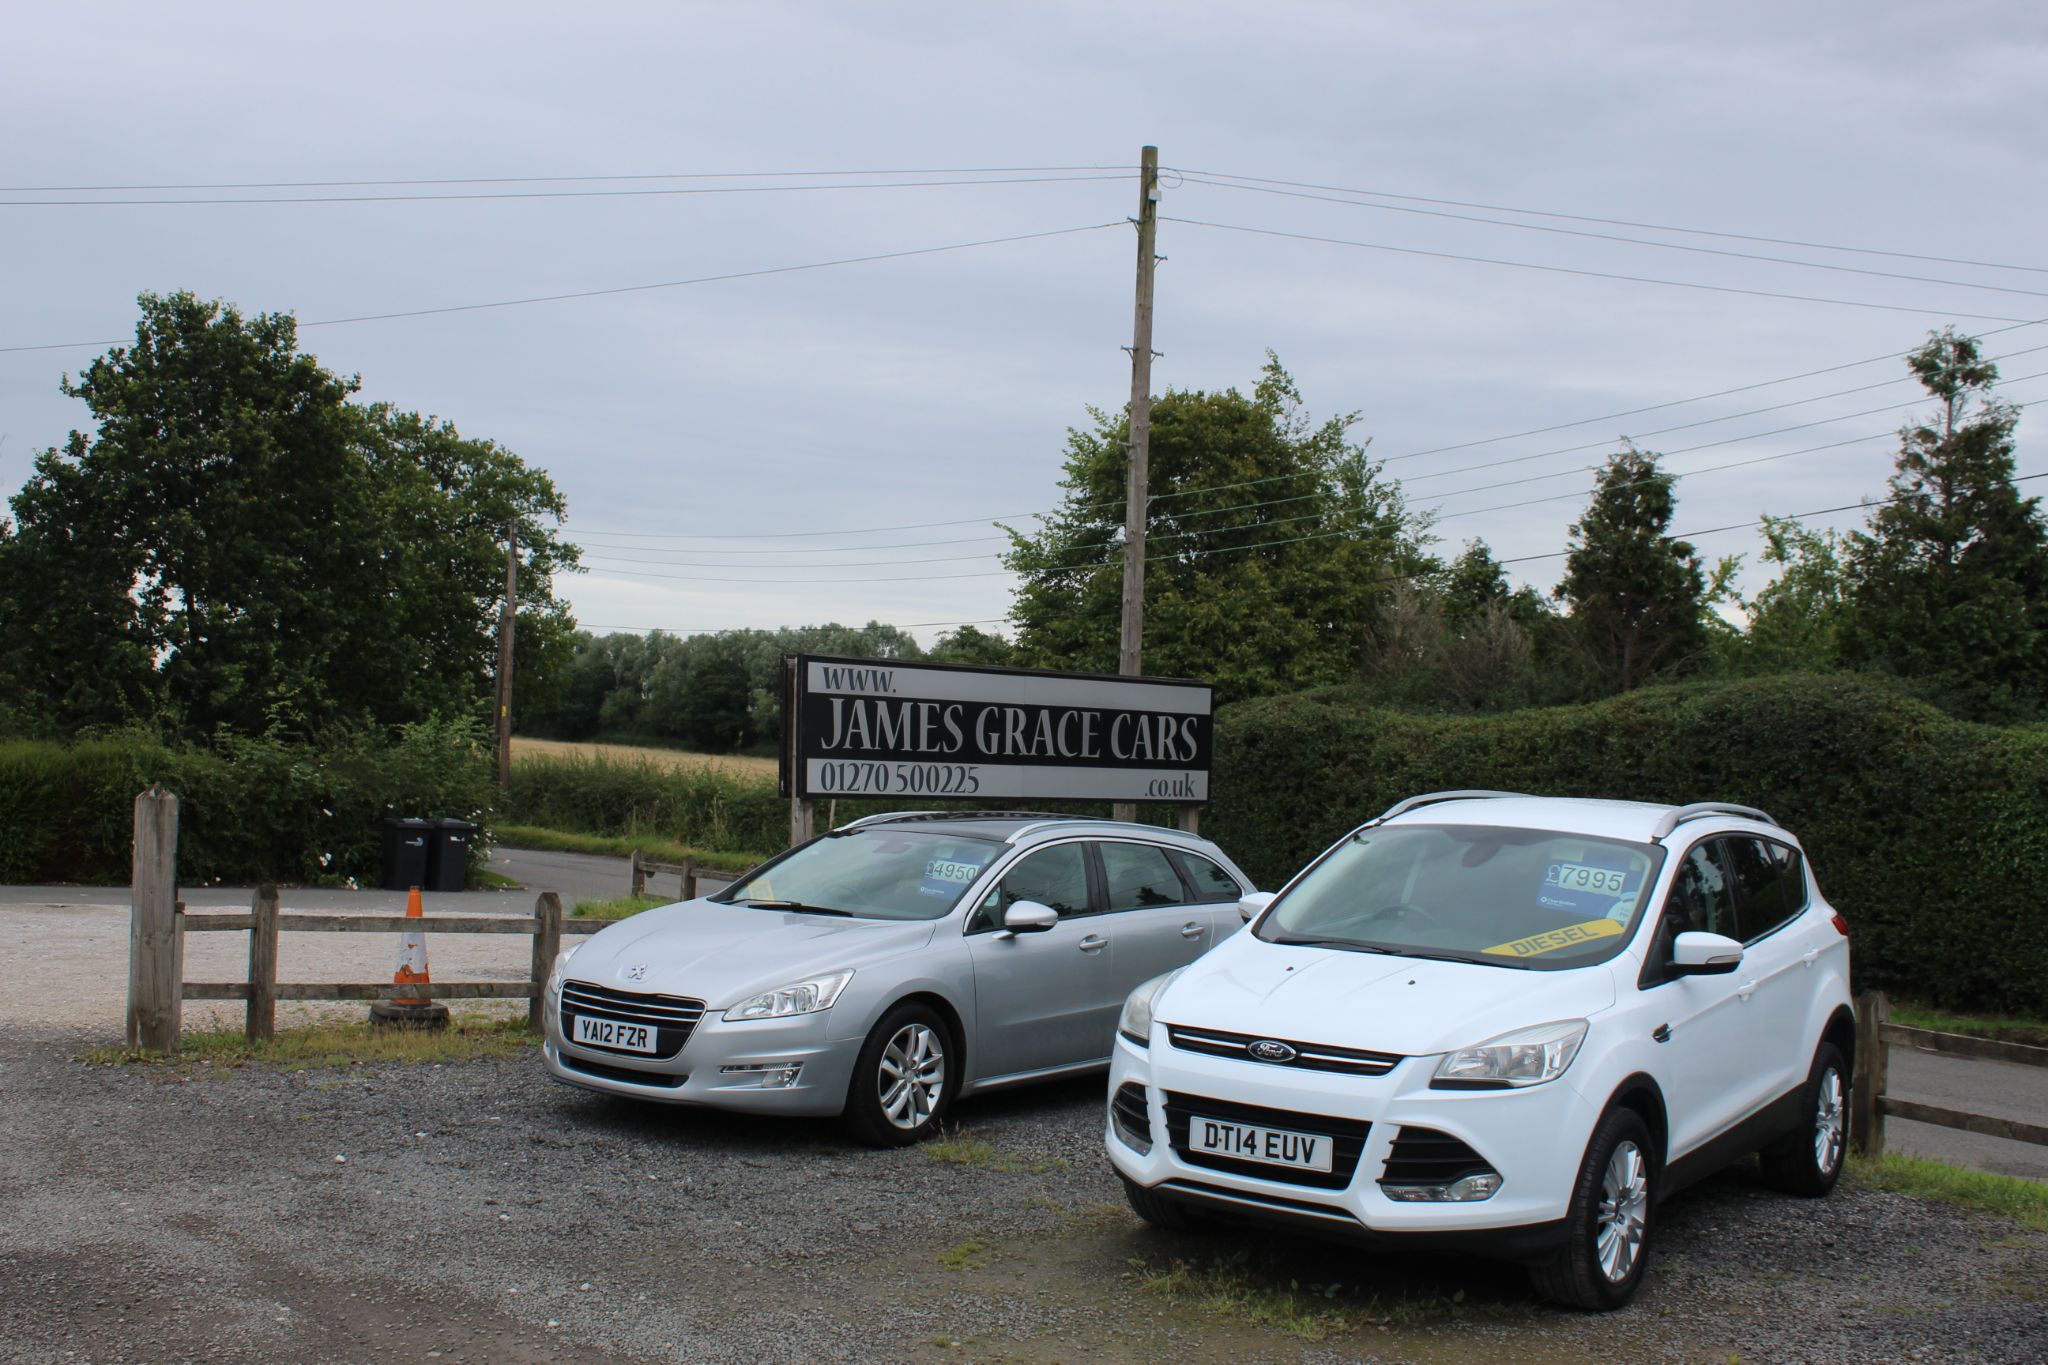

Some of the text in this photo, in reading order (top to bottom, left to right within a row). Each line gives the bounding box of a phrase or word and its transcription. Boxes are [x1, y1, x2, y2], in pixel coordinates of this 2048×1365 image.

[820, 698, 1199, 762] JAMES GRACE CARS
[820, 762, 980, 794] 01270 500225
[1144, 772, 1195, 798] .co.uk
[1510, 926, 1599, 956] DIESEL
[582, 1020, 647, 1048] YA12 FZR
[1265, 1132, 1316, 1164] EUV
